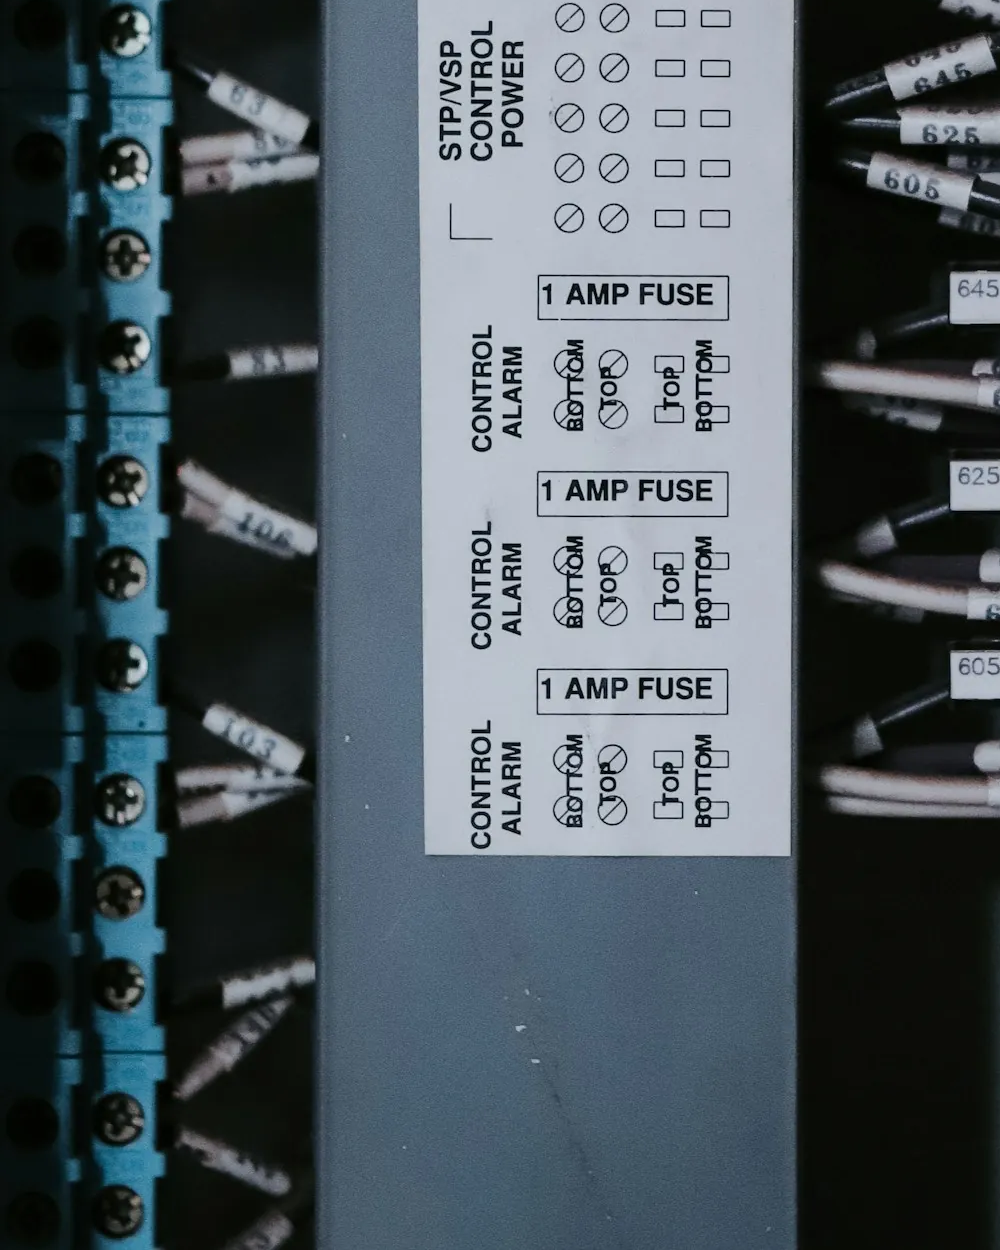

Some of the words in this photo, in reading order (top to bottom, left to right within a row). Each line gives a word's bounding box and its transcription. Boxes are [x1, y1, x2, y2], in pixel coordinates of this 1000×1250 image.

[438, 40, 463, 162] STP/VSP
[469, 20, 494, 162] CONTROL
[500, 40, 525, 148] POWER
[921, 123, 981, 146] 625
[883, 168, 941, 200] 605
[542, 283, 553, 305] 1
[565, 282, 630, 306] AMP
[639, 282, 714, 306] FUSE
[957, 279, 1000, 298] 645
[471, 324, 493, 453] CONTROL
[502, 346, 523, 439] ALARM
[566, 339, 584, 431] BOTTOM
[600, 366, 618, 411] TOP
[663, 366, 680, 411] TOP
[695, 339, 713, 432] BOTTOM
[541, 480, 552, 501] 1
[565, 479, 629, 502] AMP
[638, 478, 713, 503] FUSE
[957, 466, 1000, 485] 625
[470, 520, 493, 650] CONTROL
[501, 542, 522, 637] ALARM
[566, 536, 583, 628] BOTTOM
[600, 563, 617, 607] TOP
[662, 563, 680, 607] TOP
[695, 536, 712, 629] BOTTOM
[540, 677, 552, 699] 1
[564, 676, 629, 700] AMP
[638, 676, 713, 701] FUSE
[958, 657, 1000, 676] 605
[470, 719, 492, 850] CONTROL
[501, 741, 522, 836] ALARM
[566, 734, 583, 827] BOTTOM
[600, 762, 617, 806] TOP
[662, 762, 680, 806] TOP
[695, 734, 712, 828] BOTTOM
